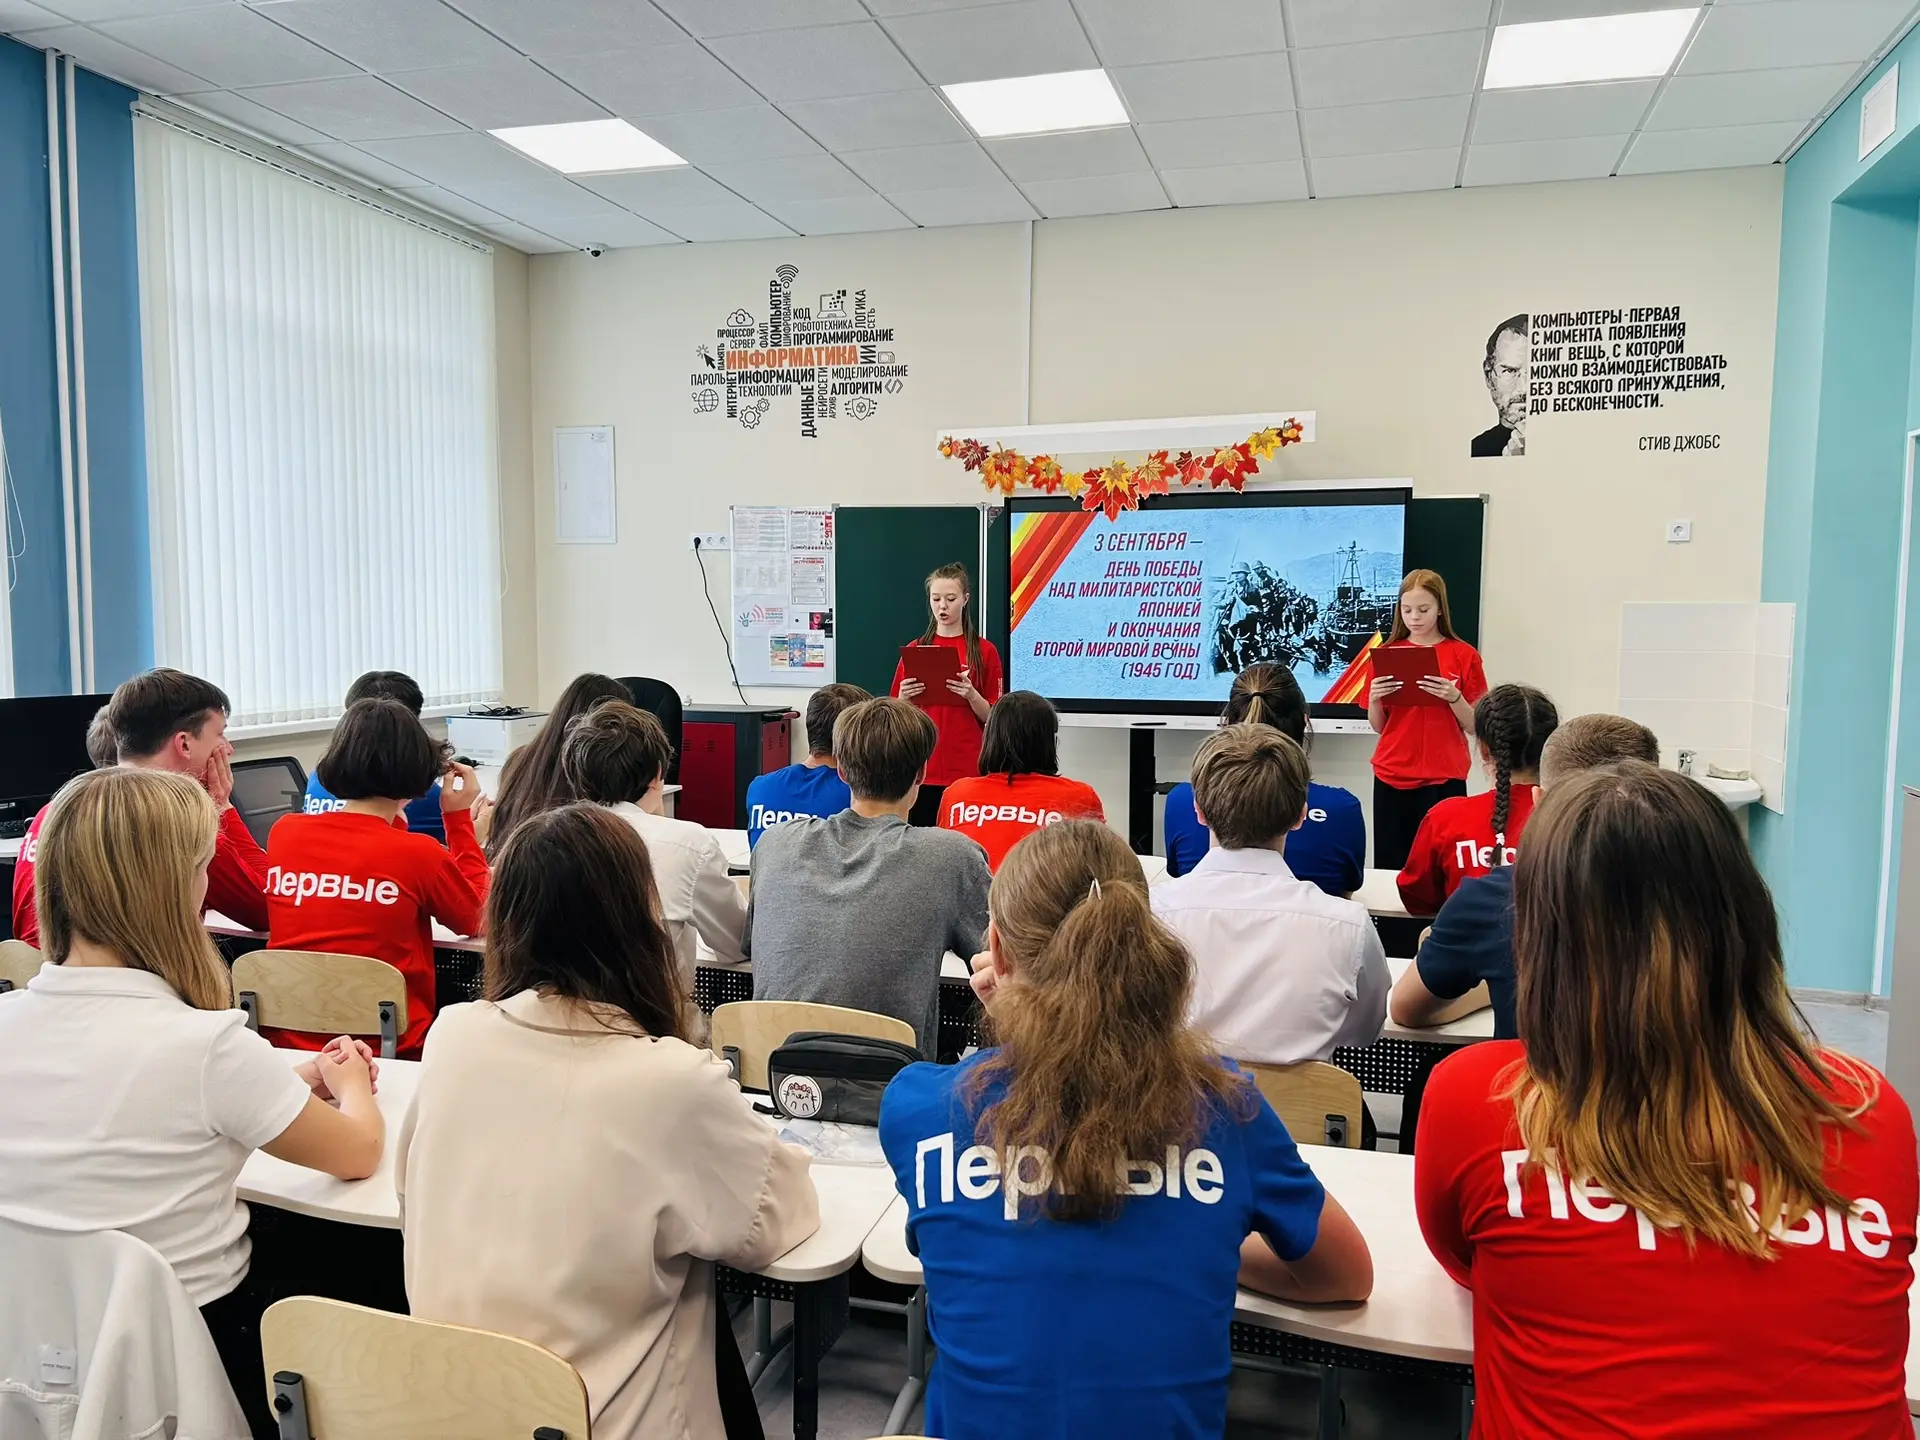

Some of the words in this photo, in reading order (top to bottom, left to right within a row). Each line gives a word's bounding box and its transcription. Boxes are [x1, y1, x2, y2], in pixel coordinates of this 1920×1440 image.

[770, 280, 782, 347] КОМПЬЮТЕР
[793, 308, 811, 320] КОД
[855, 289, 866, 328] ЛОГИКА
[783, 291, 792, 346] ШИФРОВАНИЕ
[793, 320, 853, 332] РОБОТОТЕХНИКА
[717, 328, 755, 338] ПРОЦЕССОР
[757, 323, 768, 348] ФАЙЛ
[793, 329, 894, 345] ПРОГРАММИРОВАНИЕ
[1532, 331, 1539, 345] С
[1544, 327, 1603, 345] МОМЕНТА
[1609, 322, 1685, 341] ПОЯВЛЕНИЯ
[730, 339, 755, 349] СЕРВЕР
[1531, 347, 1562, 362] КНИГ
[1568, 345, 1609, 361] ВЕЩЬ,
[1613, 343, 1620, 357] С
[1626, 336, 1684, 357] КОТОРОЙ
[726, 345, 859, 370] ИНФОРМАТИКА
[860, 345, 876, 364] ИИ
[738, 368, 815, 385] ИНФОРМАЦИЯ
[832, 365, 908, 380] МОДЕЛИРОВАНИЕ
[1530, 363, 1578, 380] МОЖНО
[1582, 354, 1727, 377] ВЗАИМОДЕЙСТВОВАТЬ
[691, 373, 725, 386] ПАРОЛЬ
[830, 381, 882, 395] АЛГОРИТМ
[1530, 382, 1553, 396] БЕЗ
[1557, 378, 1612, 395] ВСЯКОГО
[1618, 372, 1725, 392] ПРИНУЖДЕНИЯ,
[727, 372, 737, 418] ИНТЕРНЕТ
[739, 385, 792, 397] ТЕХНОЛОГИИ
[816, 367, 828, 417] НЕЙРОСЕТИ
[801, 385, 817, 438] ДАННЫЕ
[1530, 398, 1547, 415] ДО
[1553, 393, 1663, 412] БЕСКОНЕЧНОСТИ.
[1639, 436, 1670, 451] СТИВ
[1673, 434, 1720, 452] ДЖОБС
[1094, 533, 1104, 552] 3
[1108, 532, 1188, 552] СЕНТЯБРЯ
[1104, 561, 1140, 579] ДЕНЬ
[1144, 560, 1202, 577] ПОБЕДЫ
[1048, 582, 1075, 599] НАД
[1078, 577, 1202, 597] МИЛИТАРИСТСКОЙ
[1137, 599, 1201, 617] ЯПОНИЕЙ
[1107, 622, 1116, 637] И
[1120, 622, 1201, 637] ОКОНЧАНИЯ
[1034, 639, 1083, 657] ВТОРОЙ
[1086, 639, 1148, 658] МИРОВОЙ
[1121, 662, 1162, 679] (1945
[1165, 662, 1200, 679] ГОД)
[264, 865, 399, 906] Первые
[915, 1132, 1225, 1221] Перые
